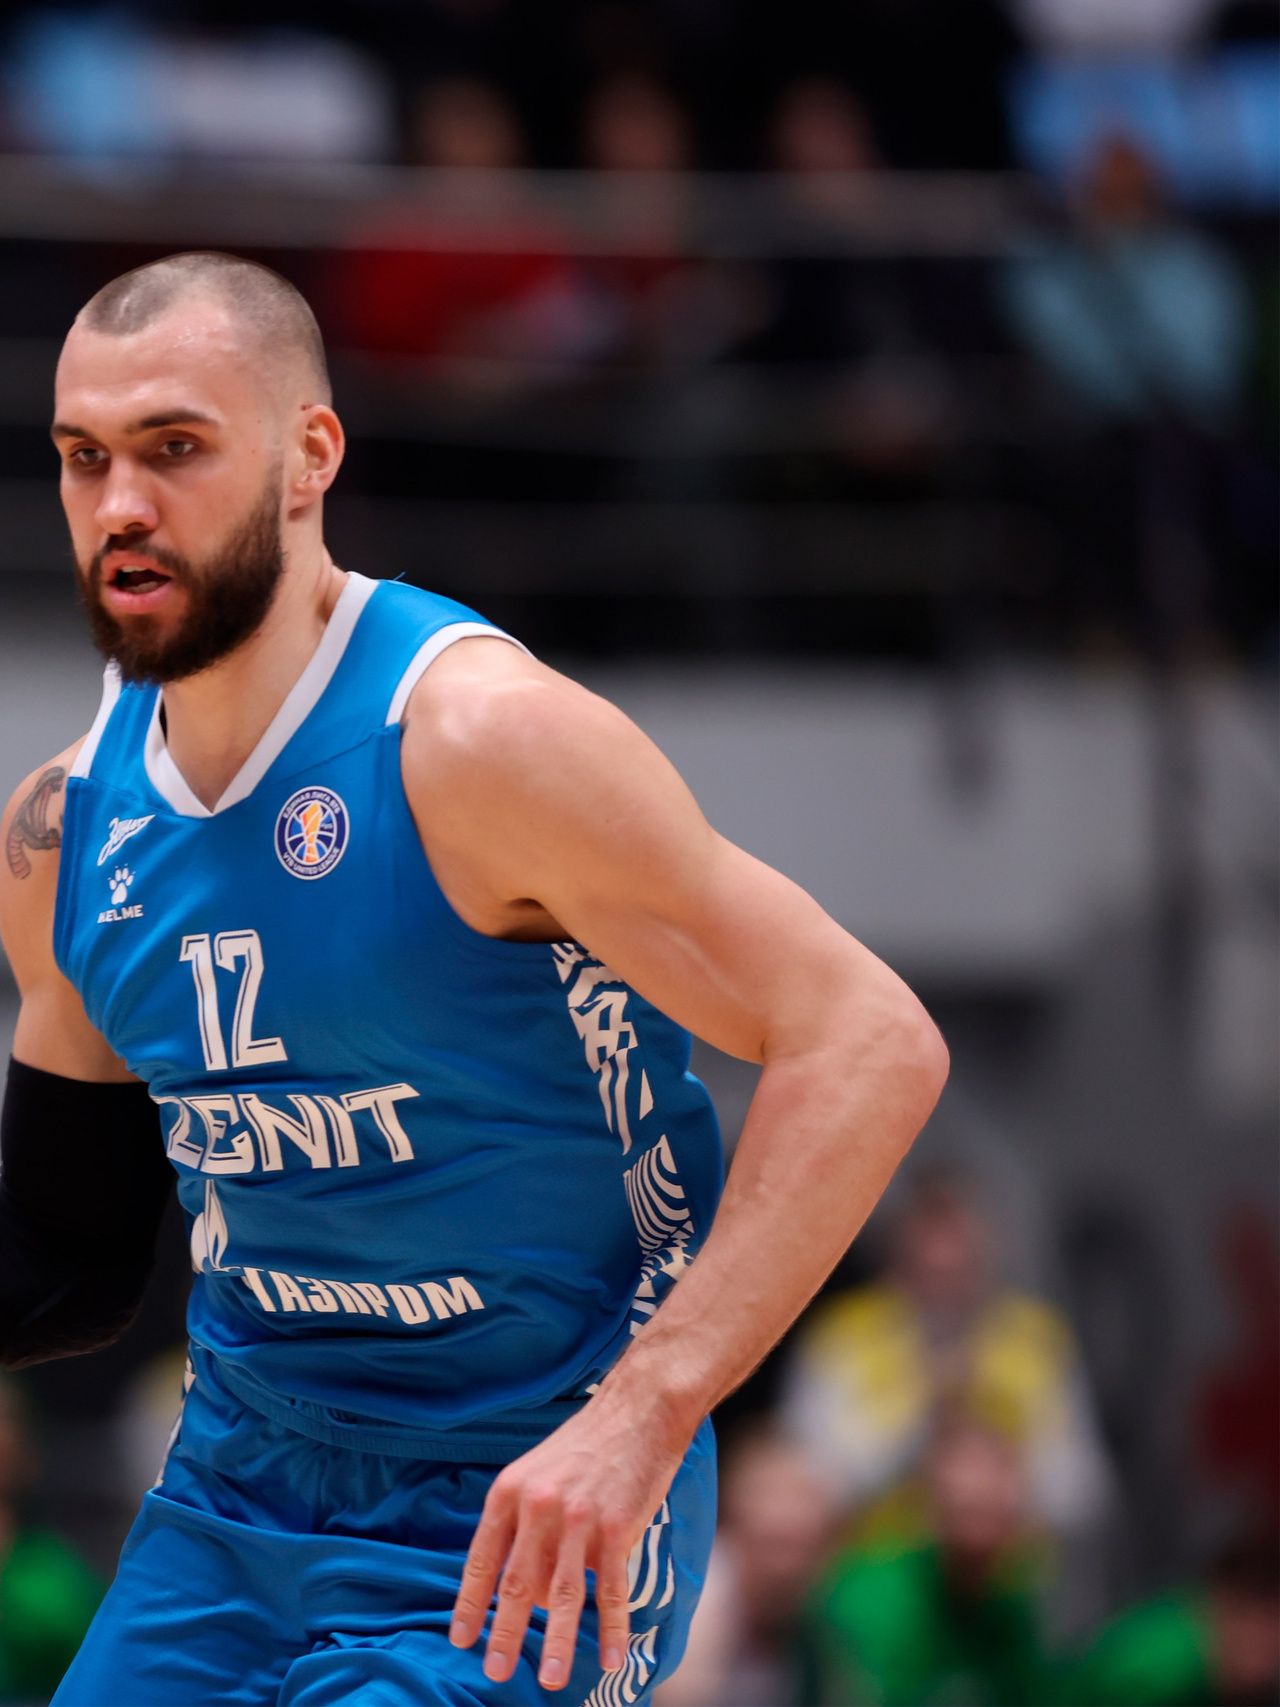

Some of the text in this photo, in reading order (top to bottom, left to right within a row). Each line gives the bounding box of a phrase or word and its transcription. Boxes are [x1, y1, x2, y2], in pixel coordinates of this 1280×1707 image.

[179, 929, 288, 1071] 12
[148, 1083, 420, 1174] ZENIT
[242, 1267, 485, 1325] ГАЗПРОМ
